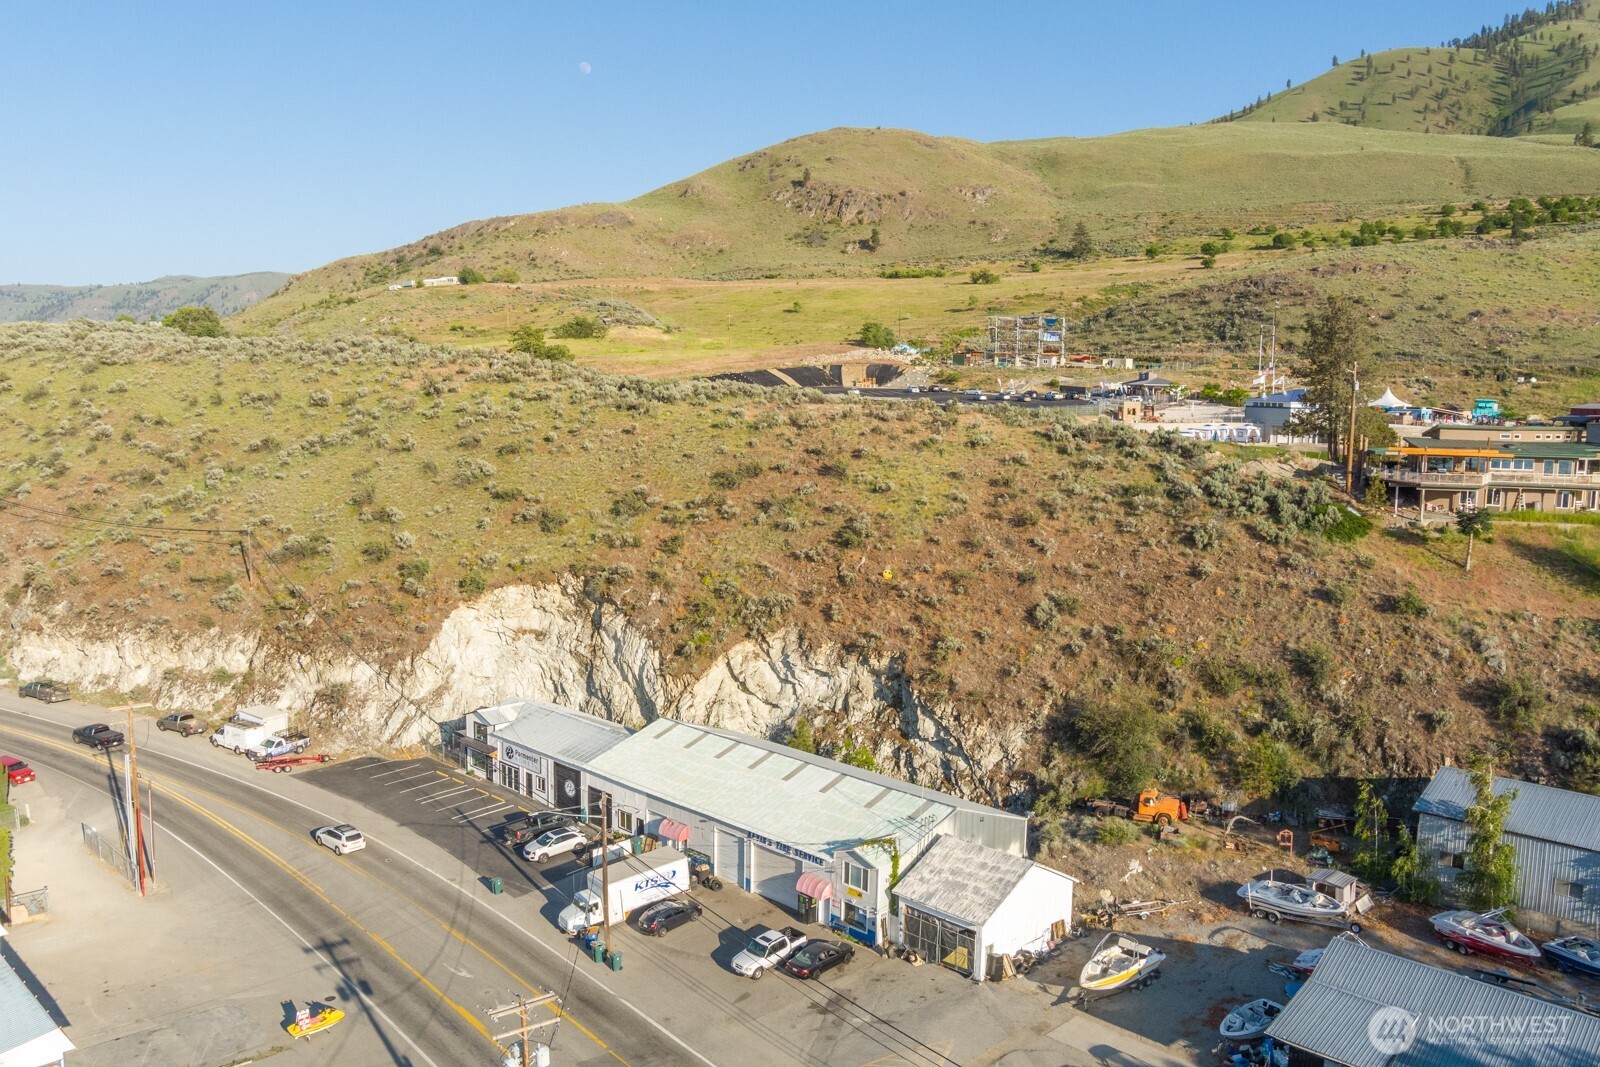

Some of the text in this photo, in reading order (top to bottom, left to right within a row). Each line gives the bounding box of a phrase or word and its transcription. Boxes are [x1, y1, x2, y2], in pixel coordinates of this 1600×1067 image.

[515, 749, 539, 764] Parmenter
[775, 841, 791, 854] TIRE
[794, 849, 825, 867] SERVICE
